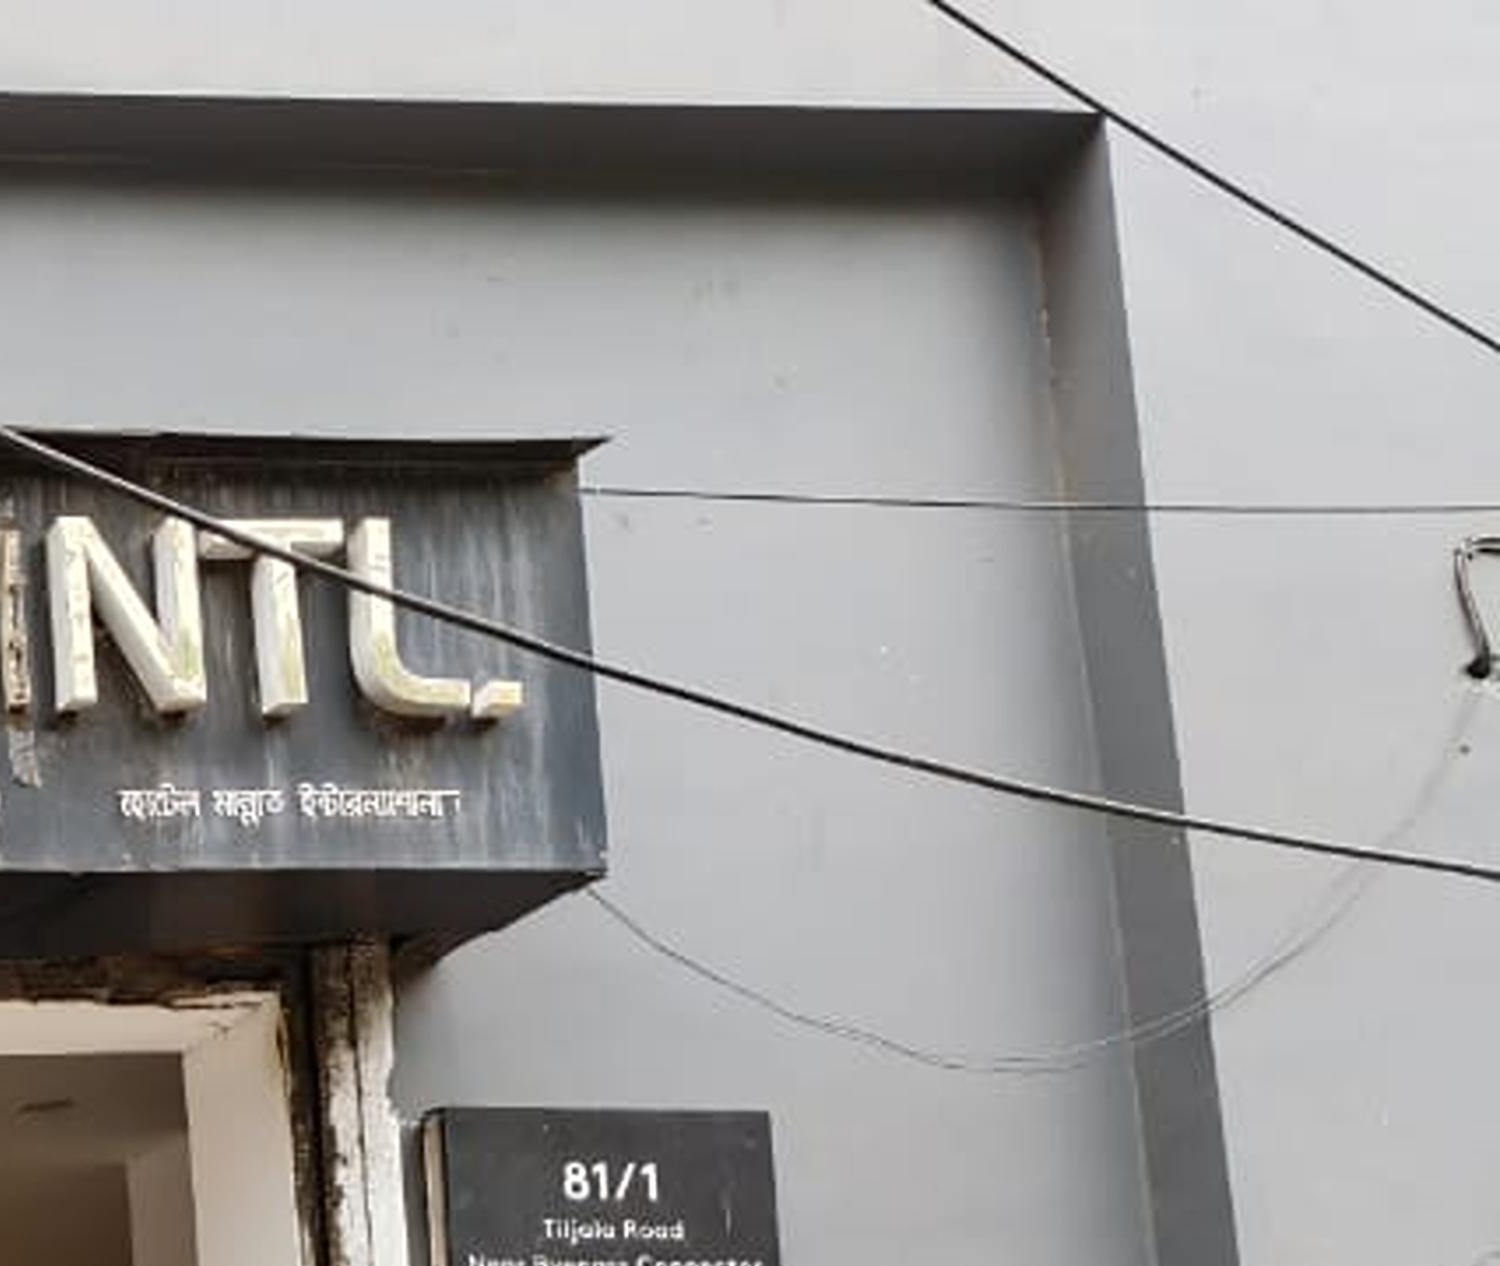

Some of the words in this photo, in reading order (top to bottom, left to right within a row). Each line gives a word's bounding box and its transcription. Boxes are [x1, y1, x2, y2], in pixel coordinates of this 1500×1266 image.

[562, 1160, 660, 1203] 81/1
[542, 1217, 617, 1246] Tiljala
[622, 1217, 686, 1241] Road
